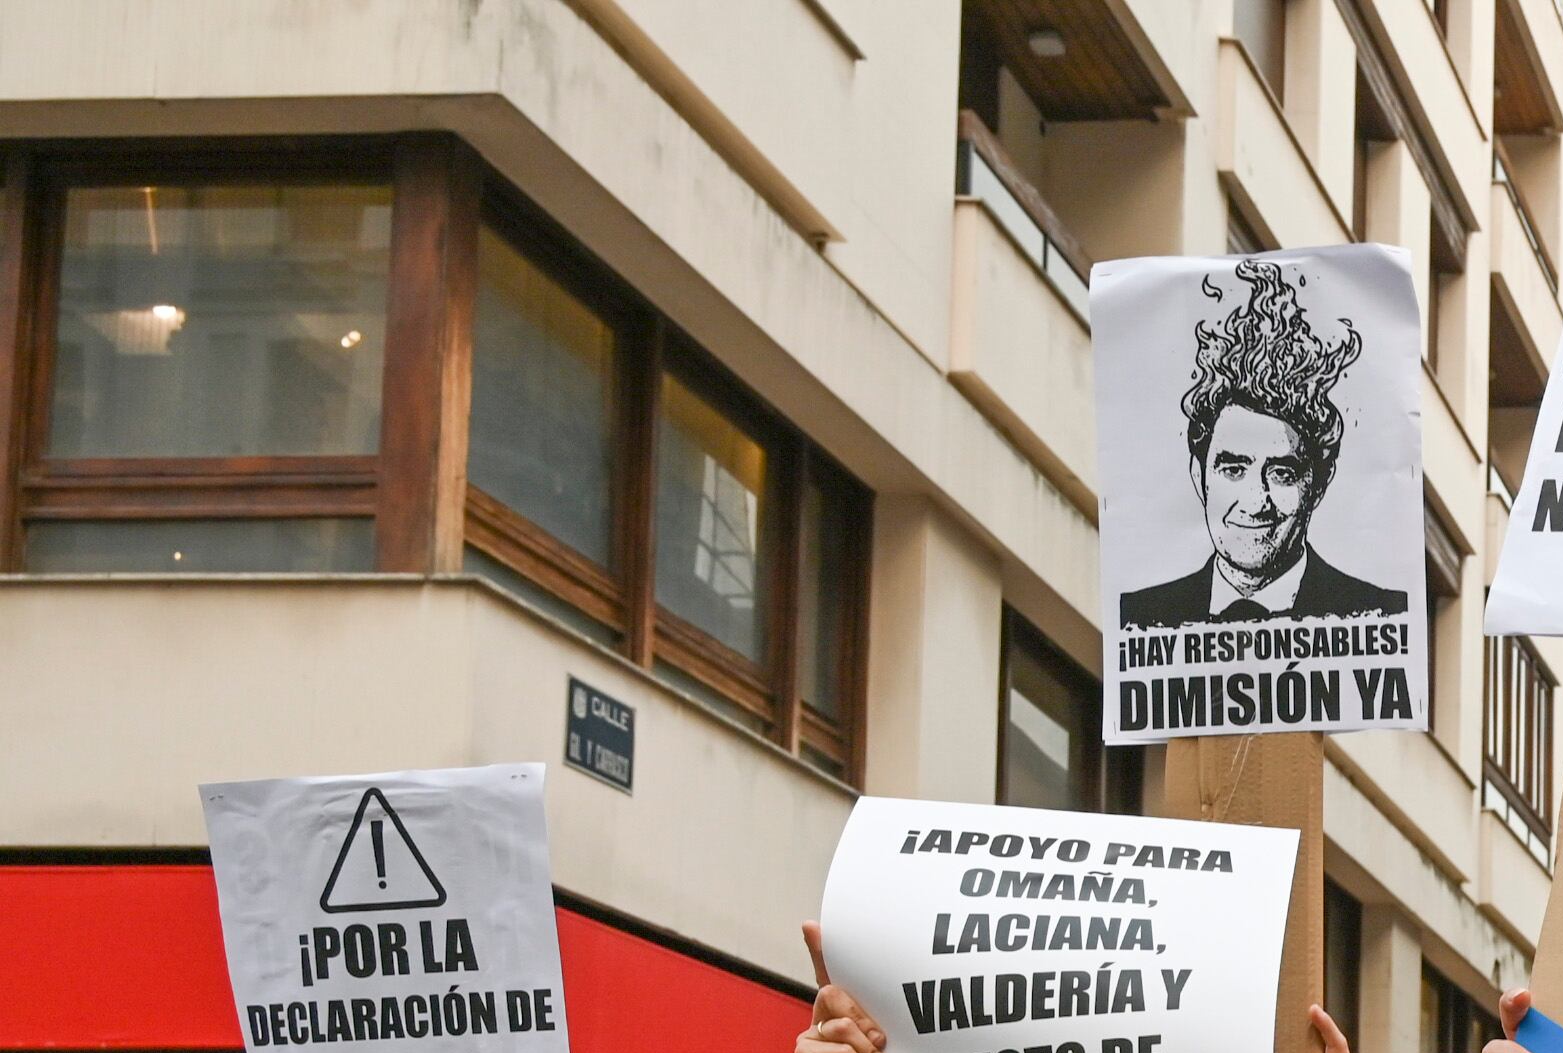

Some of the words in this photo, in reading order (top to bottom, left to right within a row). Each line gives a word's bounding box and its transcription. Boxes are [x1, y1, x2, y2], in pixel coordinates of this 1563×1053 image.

[1119, 635, 1177, 672] ¡HAY
[1184, 624, 1409, 664] RESPONSABLES!
[591, 696, 630, 732] CALLE
[1119, 662, 1341, 731] DIMISIÓN
[1353, 667, 1413, 720] YA
[900, 828, 1091, 864] ¡APOYO
[1103, 841, 1233, 873] PARA
[959, 868, 1158, 908] OMAÑA,
[299, 922, 411, 987] ¡POR
[419, 918, 479, 974] LA
[932, 913, 1167, 955] LACIANA,
[246, 985, 498, 1047] DECLARACIÓN
[505, 988, 556, 1034] DE
[902, 962, 1146, 1035] VALDERÍA
[1160, 968, 1193, 1010] Y
